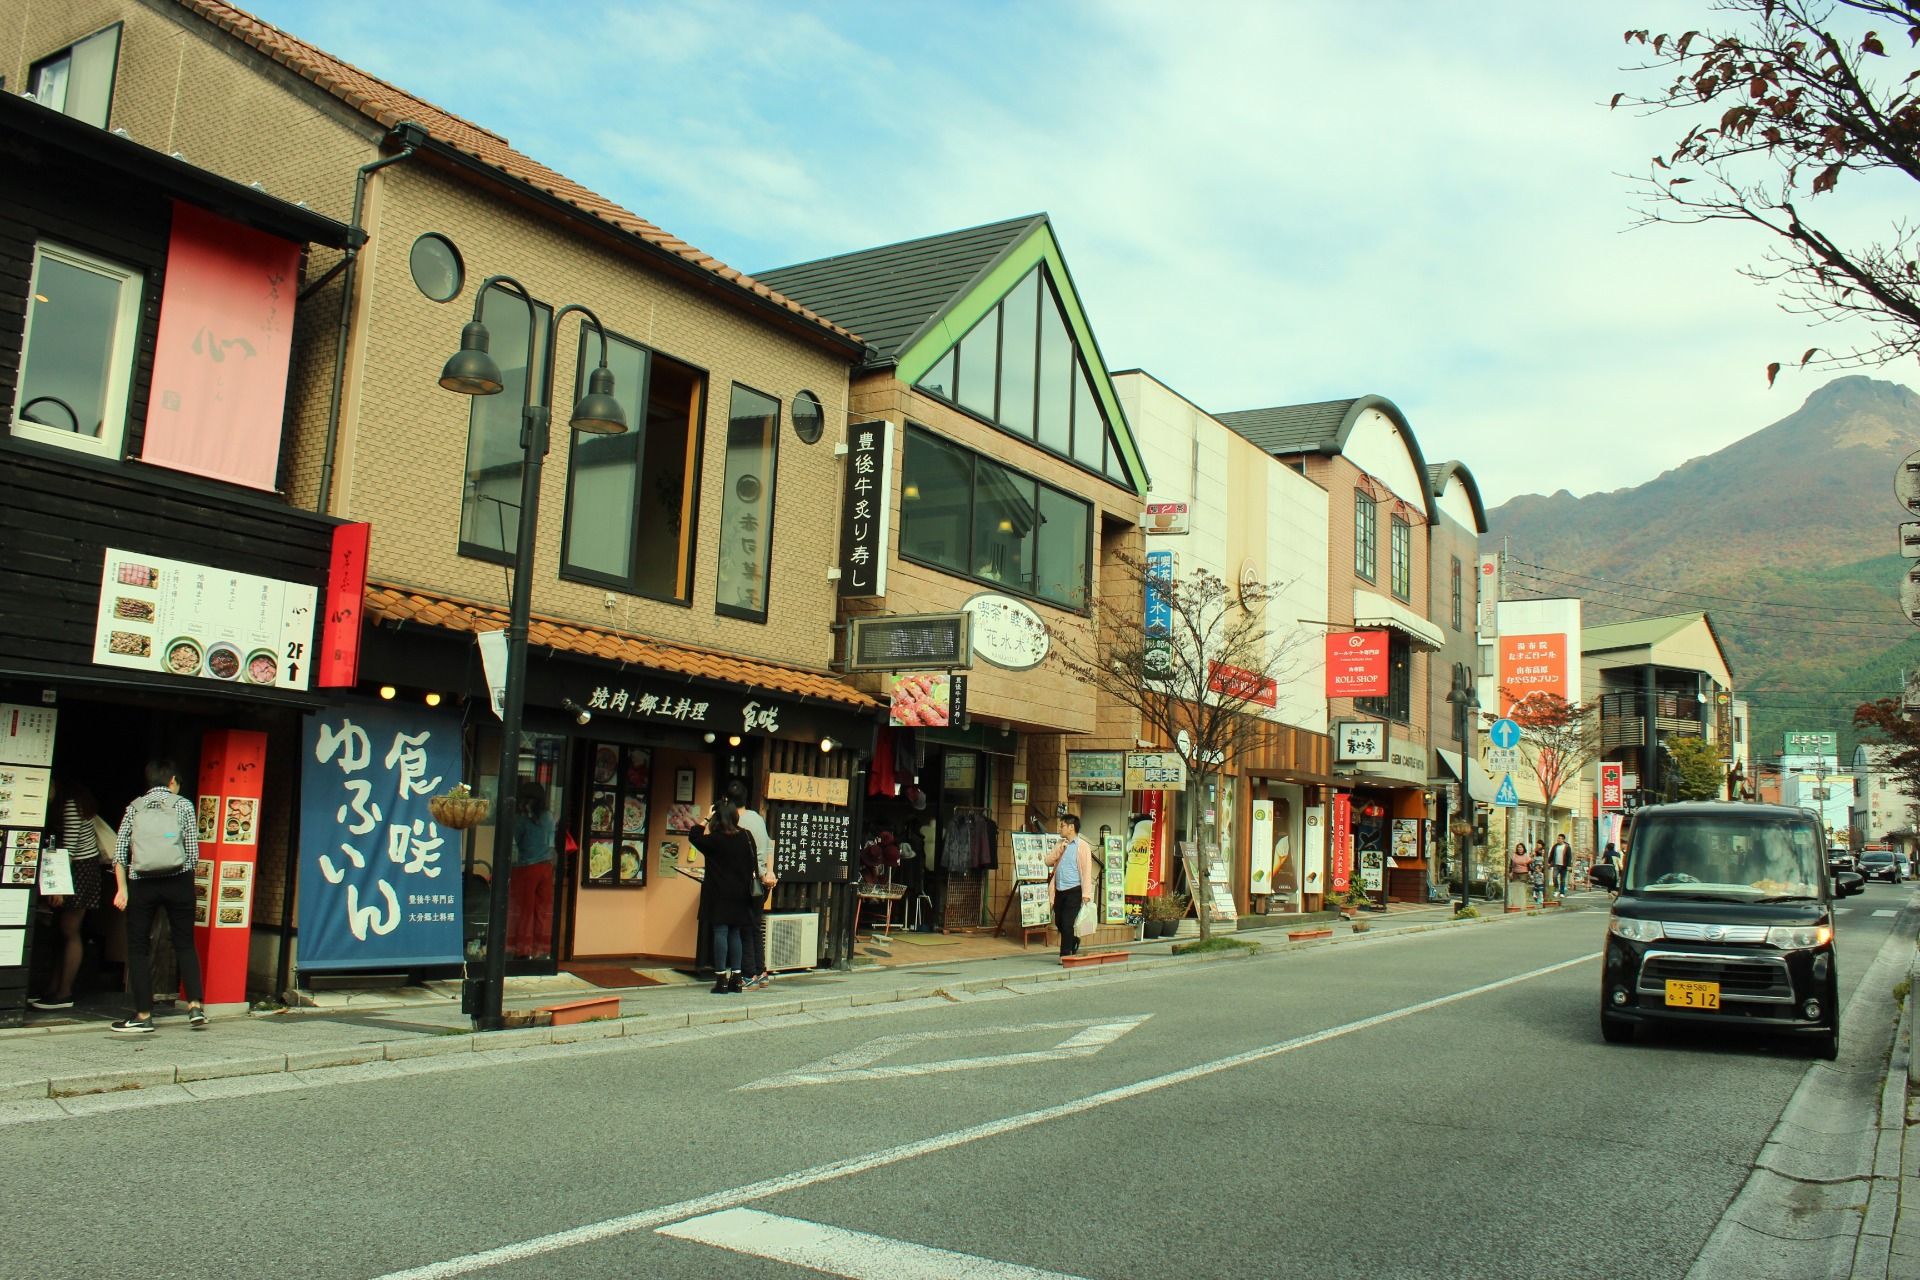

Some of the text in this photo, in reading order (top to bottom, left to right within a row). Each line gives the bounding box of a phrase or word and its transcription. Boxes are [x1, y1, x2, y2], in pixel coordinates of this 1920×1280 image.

[850, 432, 875, 587] 豊後牛炙り寿し
[978, 601, 1002, 622] 喫茶
[287, 641, 304, 659] 2F
[985, 628, 1027, 653] 花水木
[1335, 675, 1378, 684] ROLL SHOP
[588, 686, 709, 721] 焼肉・郷土料理
[954, 676, 962, 725] 豊後牛炙り寿し
[1129, 756, 1162, 768] 軽食
[1146, 769, 1179, 782] 喫茶
[1604, 784, 1619, 803] 薬
[315, 718, 401, 941] ゆふいん
[839, 816, 850, 862] 郷土料理
[798, 813, 809, 873] 豊後牛焼肉
[408, 893, 455, 905] 豊後牛専門店
[408, 911, 455, 922] 大分郷土料理
